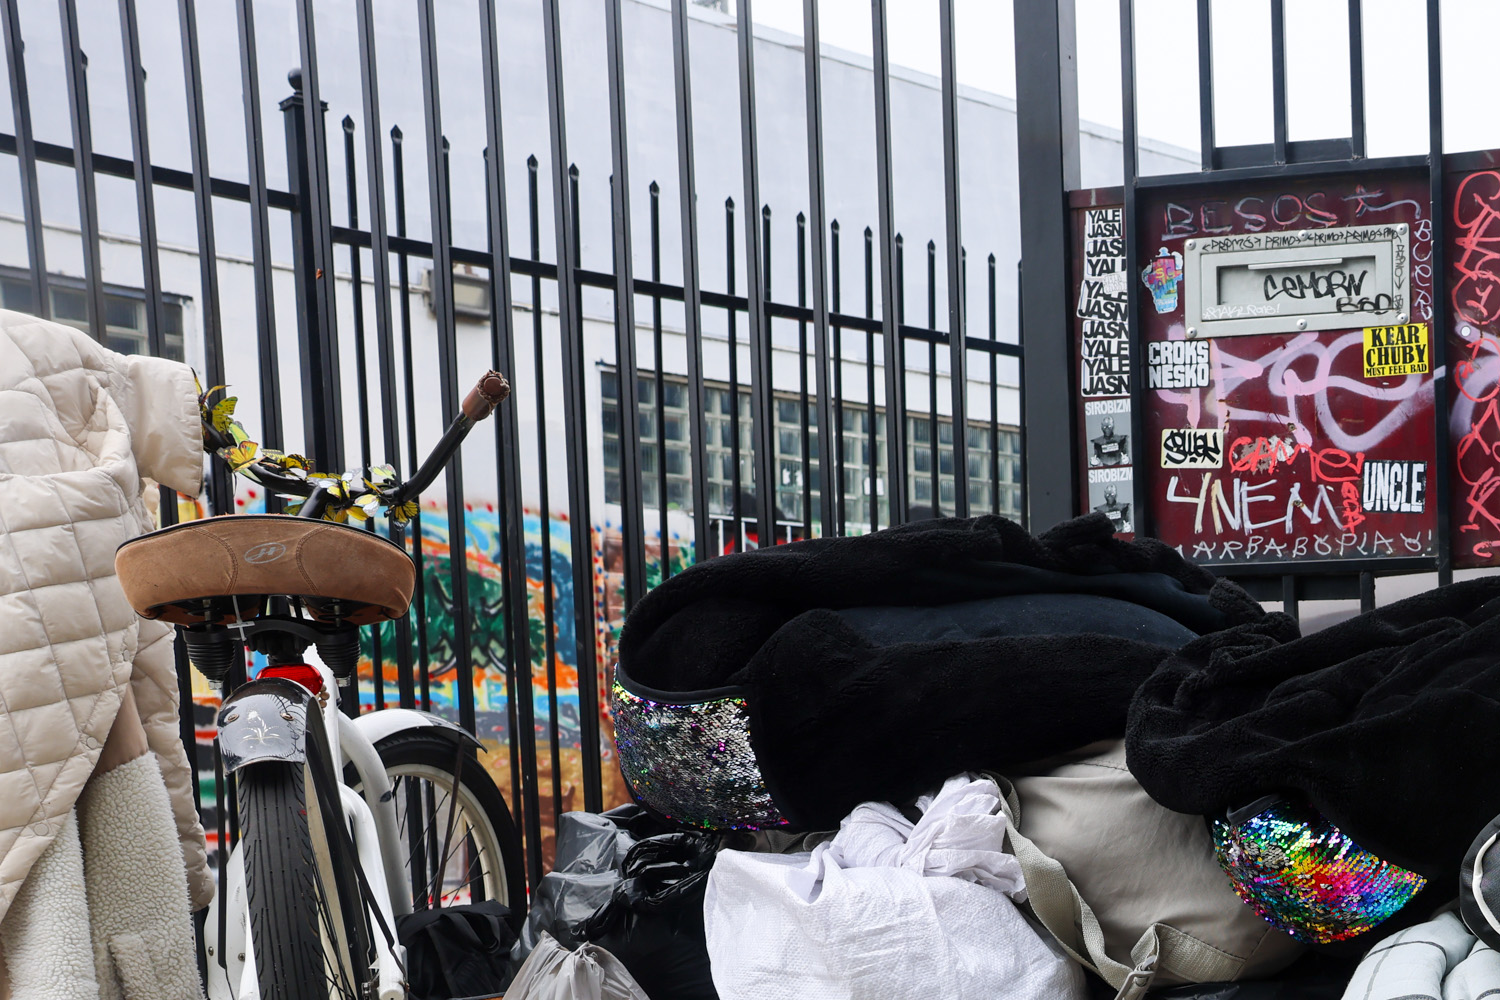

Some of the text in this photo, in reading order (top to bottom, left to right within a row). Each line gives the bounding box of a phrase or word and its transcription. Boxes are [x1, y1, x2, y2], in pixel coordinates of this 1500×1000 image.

[1088, 210, 1120, 223] YALE
[1088, 223, 1121, 238] JASN
[1078, 300, 1129, 321] JASN
[1084, 340, 1129, 358] YALE
[1148, 340, 1209, 365] CROKS
[1366, 344, 1426, 367] CHUBY
[1085, 358, 1130, 376] YALE
[1149, 364, 1209, 388] NESKO
[1366, 364, 1427, 376] MUST FEEL BAD
[1082, 375, 1131, 395] JASN
[1363, 462, 1424, 512] UNCLE
